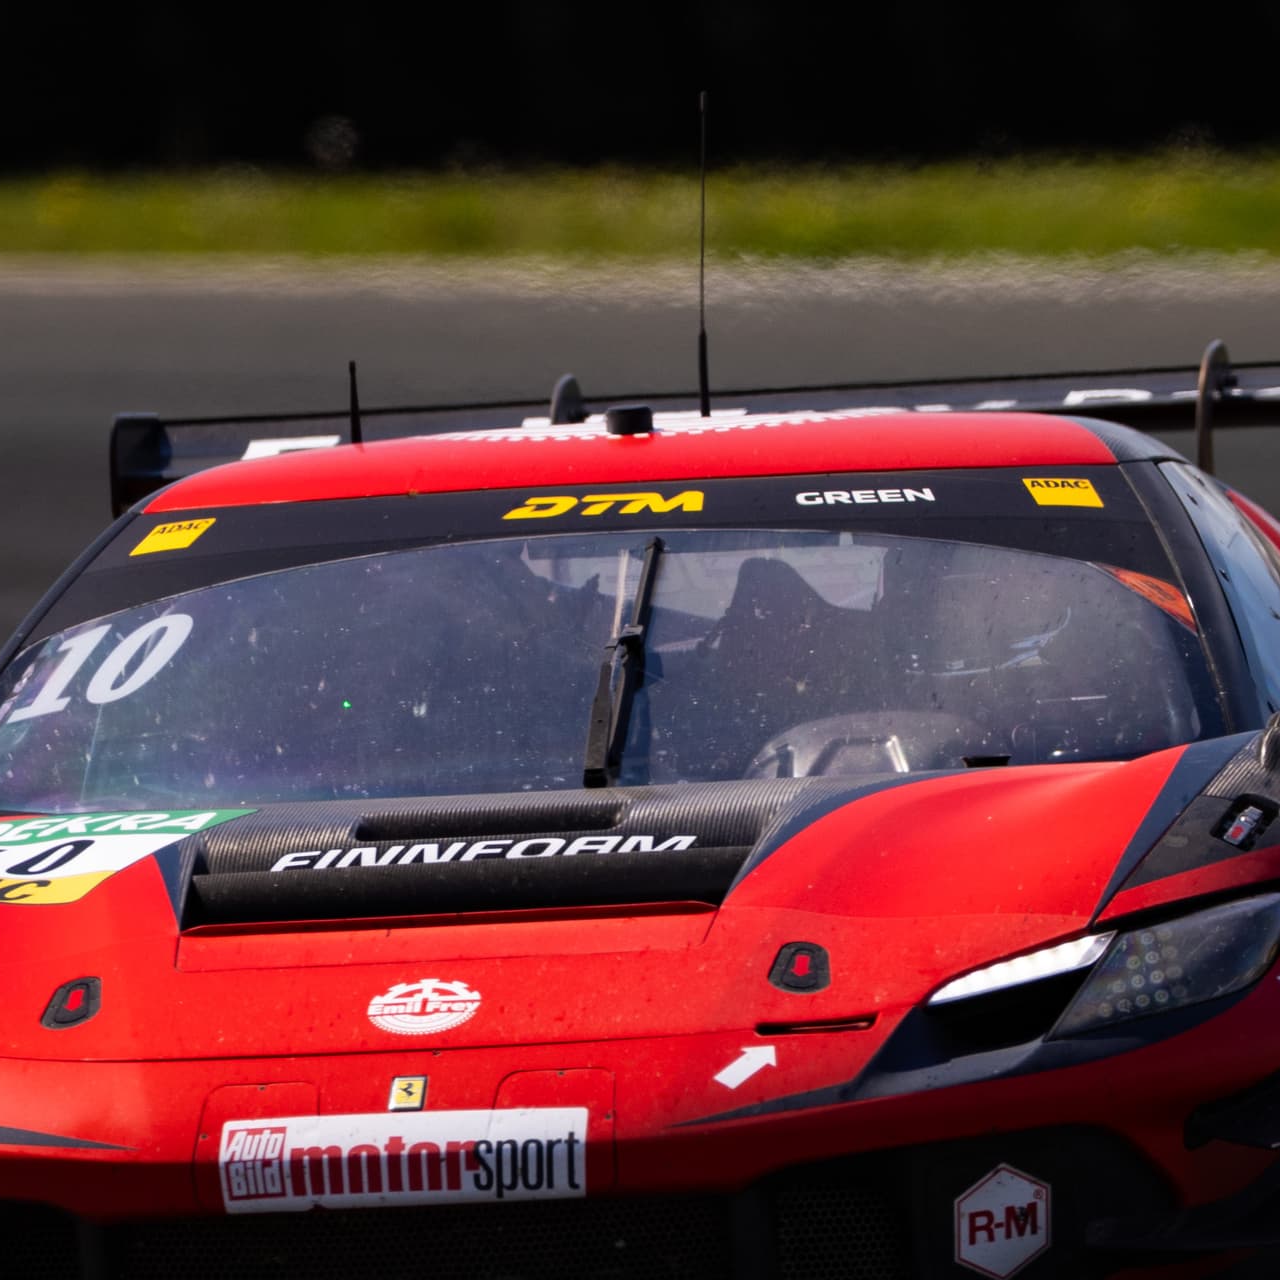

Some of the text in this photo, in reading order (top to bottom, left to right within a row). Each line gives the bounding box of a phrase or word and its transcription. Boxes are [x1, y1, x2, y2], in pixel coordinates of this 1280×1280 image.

[795, 488, 936, 505] GREEN
[1030, 479, 1090, 490] ADAC
[502, 490, 704, 520] DTM
[154, 519, 210, 535] ADAC
[6, 613, 194, 724] 10
[270, 835, 698, 872] FINNFORM
[367, 998, 481, 1016] Emil Frey
[225, 1131, 284, 1161] Auto
[229, 1157, 282, 1197] Bild
[969, 1202, 1038, 1246] R-M
